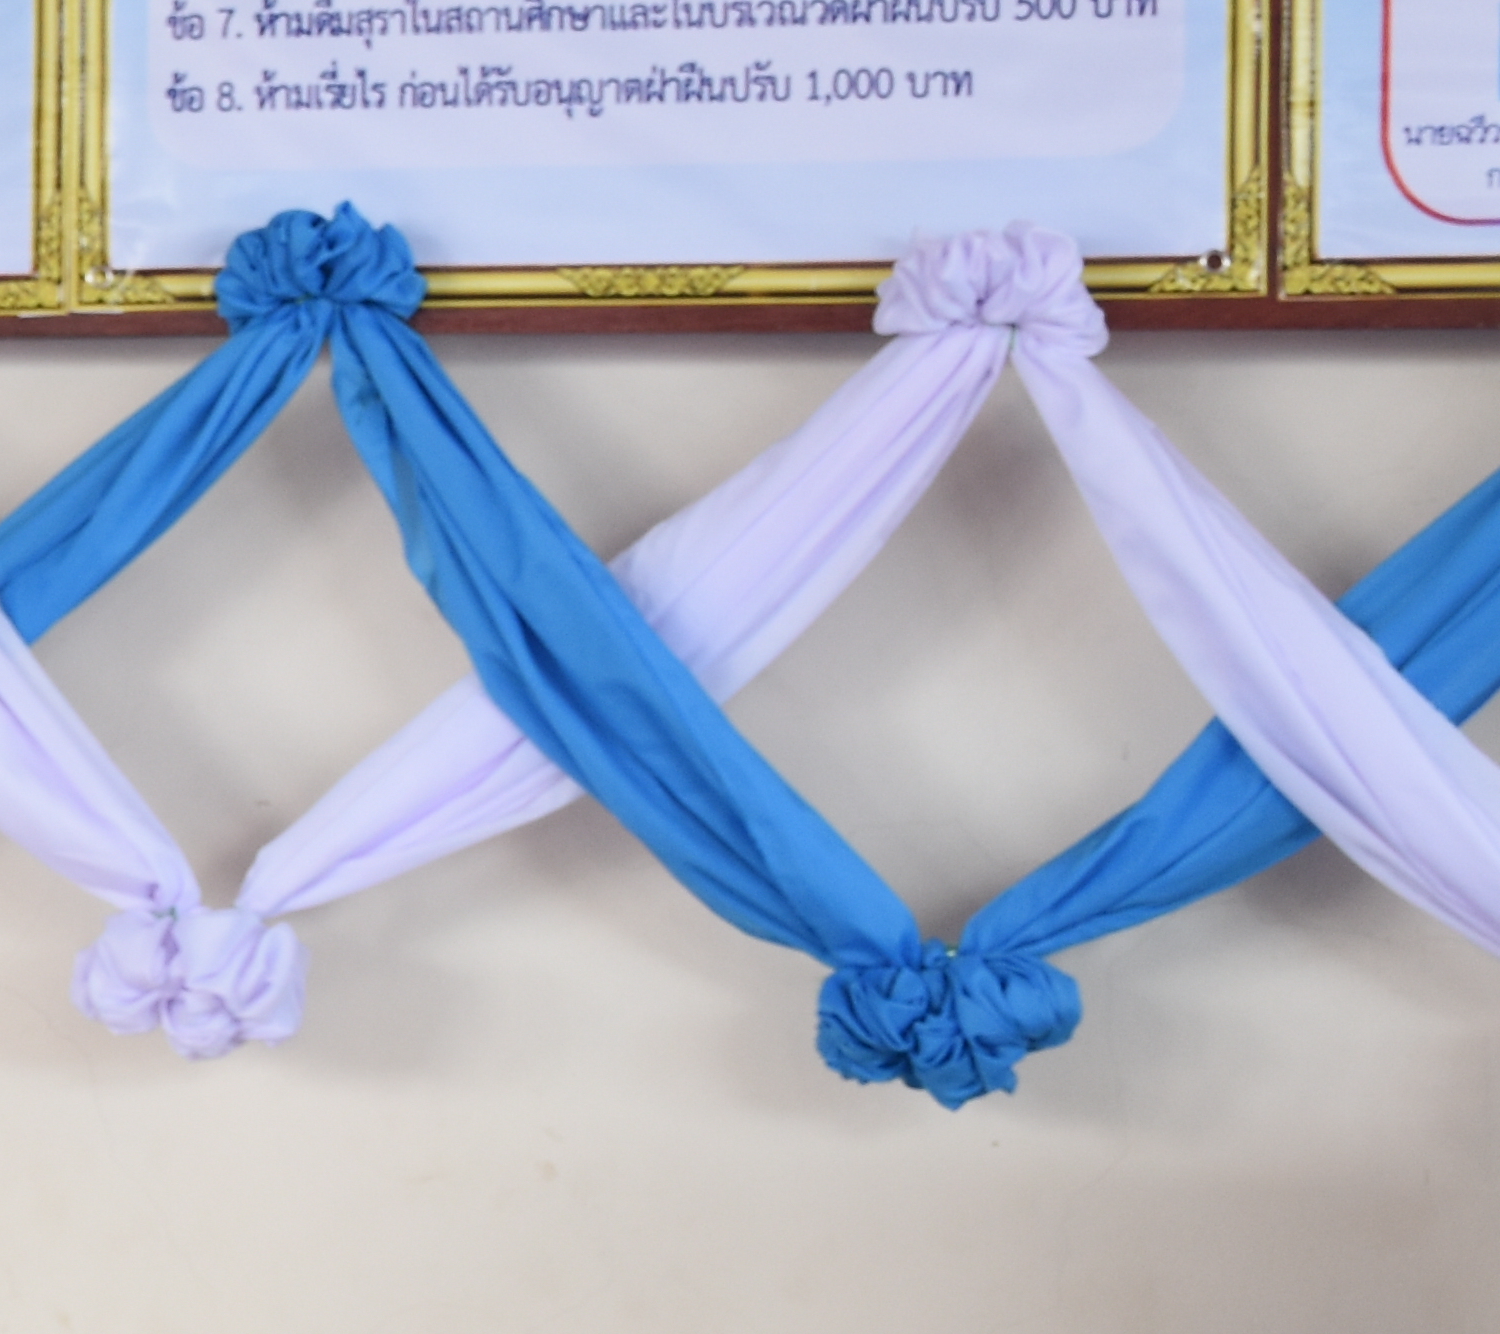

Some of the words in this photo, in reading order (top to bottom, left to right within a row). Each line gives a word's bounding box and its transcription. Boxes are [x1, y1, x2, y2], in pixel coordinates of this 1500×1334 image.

[166, 0, 205, 40] ข้อ
[217, 7, 243, 39] 7.
[165, 72, 204, 113] ข้อ
[216, 81, 243, 112] 8.
[807, 67, 895, 105] 1,000
[906, 70, 973, 99] บาท
